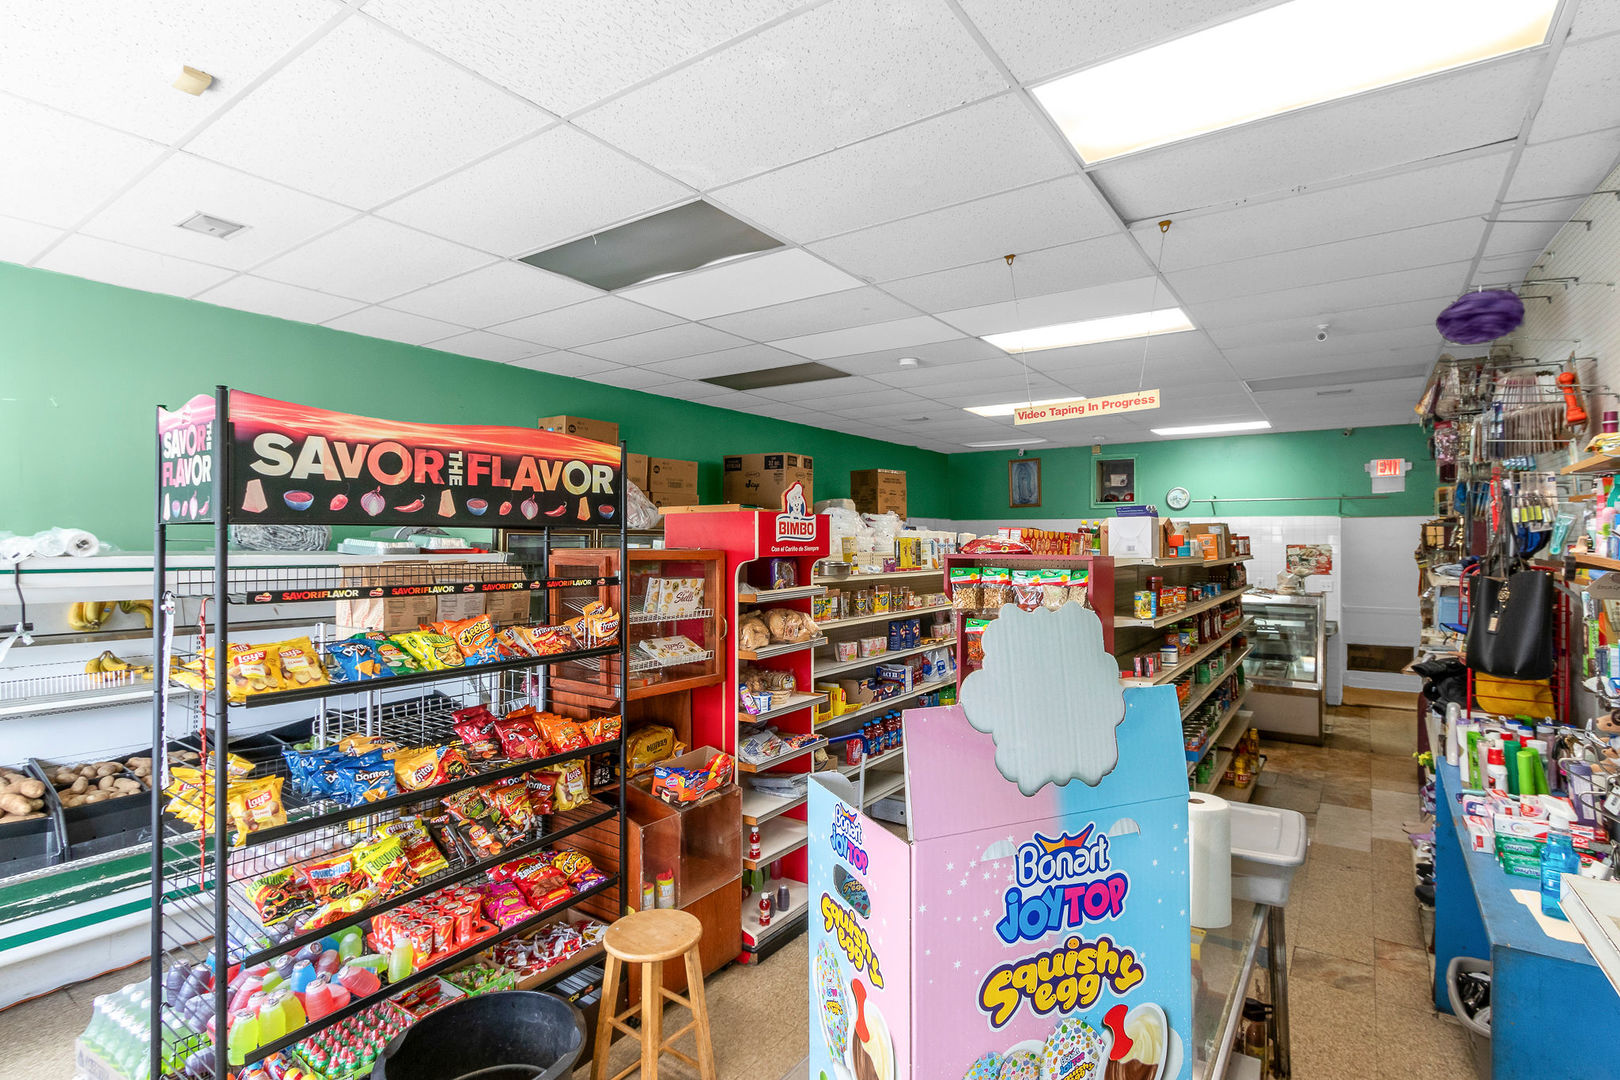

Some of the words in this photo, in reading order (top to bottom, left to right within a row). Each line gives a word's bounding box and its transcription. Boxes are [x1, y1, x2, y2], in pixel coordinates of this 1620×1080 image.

[1017, 410, 1046, 420] Video
[1049, 405, 1085, 417] Taping
[1088, 402, 1098, 411] In
[1102, 396, 1155, 410] Progress
[163, 424, 207, 459] SAVOR
[162, 455, 212, 487] FLAVOR
[250, 432, 445, 486] SAVOR
[448, 450, 463, 487] THE
[467, 452, 614, 495] FLAVOR
[1377, 460, 1400, 476] EXIT
[778, 521, 814, 535] BIMBO
[282, 590, 318, 601] SAVOR
[322, 589, 359, 599] FLAVOR
[391, 586, 421, 596] SAVOR
[424, 585, 454, 594] FLAVOR
[482, 583, 506, 591] SAVOR
[546, 580, 568, 588] SAVOR
[569, 579, 592, 587] FLAVOR
[459, 619, 491, 647] Cheetos
[239, 651, 265, 664] Lay's
[355, 769, 390, 782] Doritos
[413, 763, 434, 783] Fritos
[567, 769, 582, 781] Lay's
[835, 804, 863, 844] Bonart
[1018, 834, 1110, 886] Bonart
[822, 893, 884, 989] Squishy
[837, 930, 864, 972] egg
[979, 936, 1146, 1029] Squishy
[1033, 972, 1101, 1015] egg
